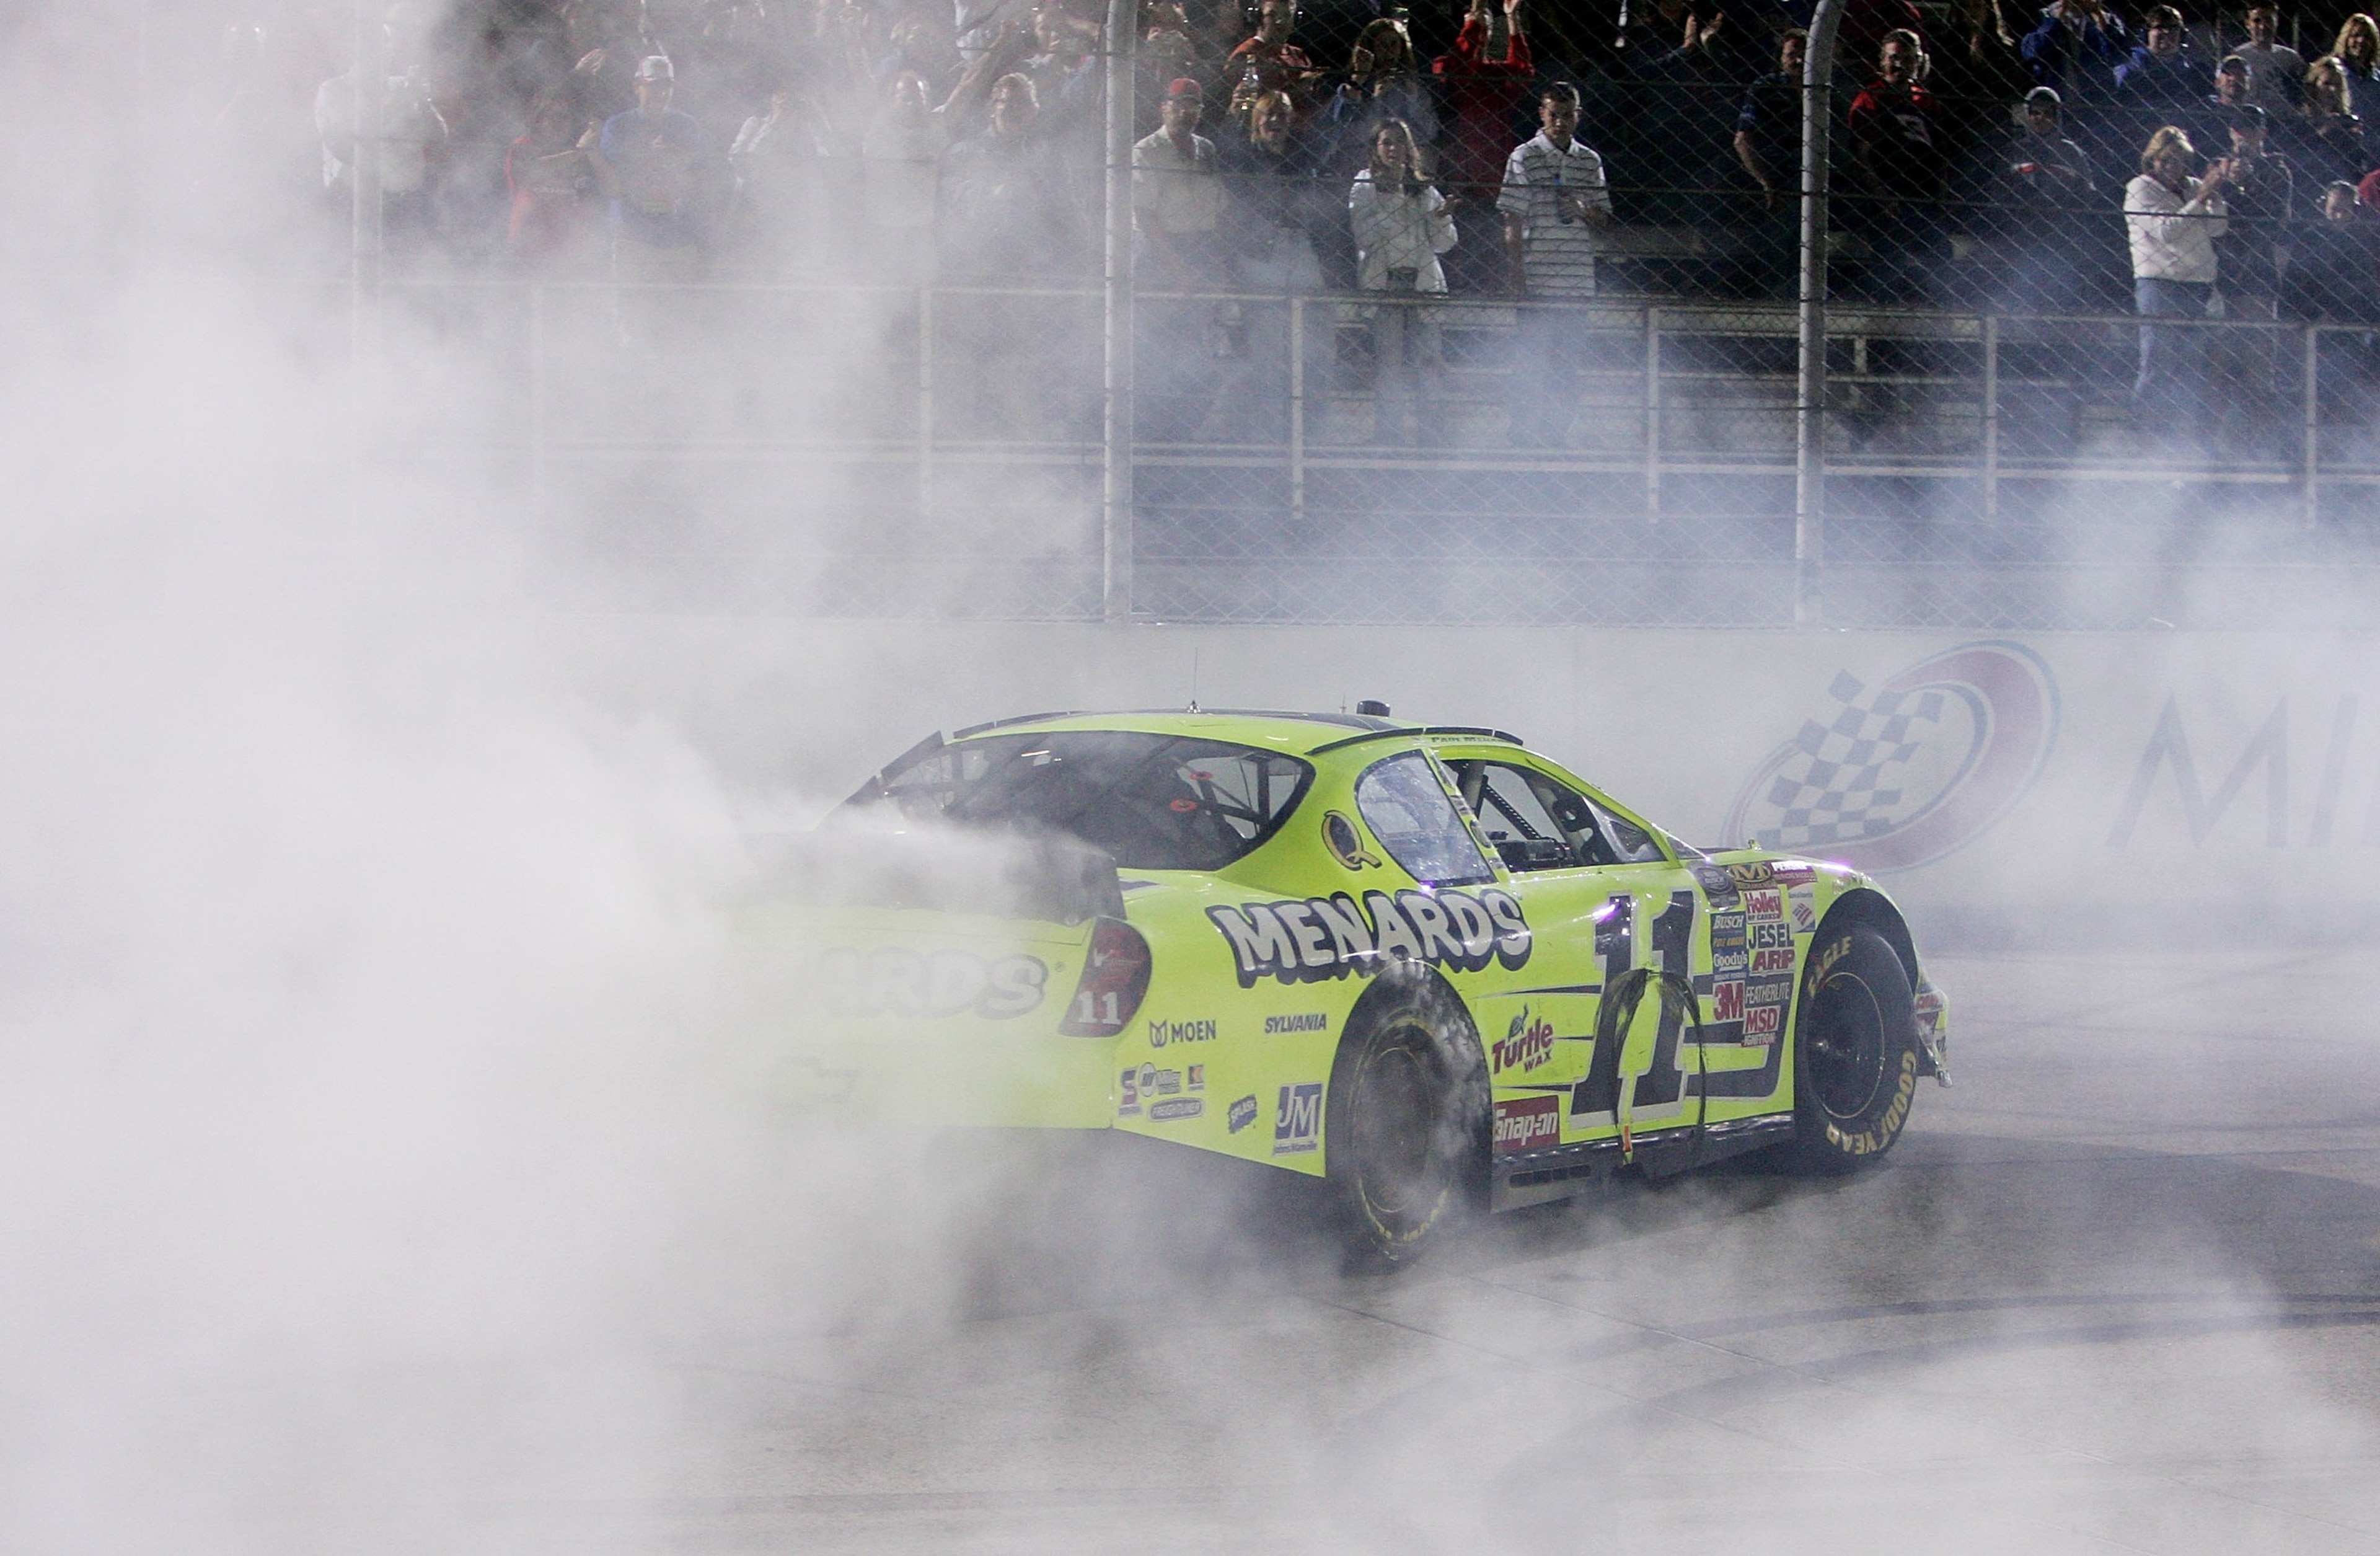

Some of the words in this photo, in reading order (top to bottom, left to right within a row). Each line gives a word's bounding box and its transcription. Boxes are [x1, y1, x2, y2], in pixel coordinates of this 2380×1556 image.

[1744, 891, 1781, 915] Holley
[1713, 915, 1745, 929] BUSCH
[1206, 889, 1532, 988] MENARDS
[1748, 924, 1795, 949] JESEL
[1713, 951, 1748, 968] Goody's
[1752, 949, 1796, 971] ARP
[1714, 982, 1744, 1021] 3M
[1745, 981, 1790, 1004] FEATHERLITE
[1078, 992, 1121, 1025] 11
[1569, 890, 1695, 1129] 11
[1745, 1007, 1778, 1033] MSD
[1171, 1020, 1216, 1043] MOEN
[1265, 1014, 1327, 1033] SYLVANIA
[1492, 1015, 1554, 1075] Turtle
[1524, 1050, 1553, 1072] WAX
[1276, 1085, 1320, 1139] JM
[1494, 1108, 1558, 1146] Snap-on
